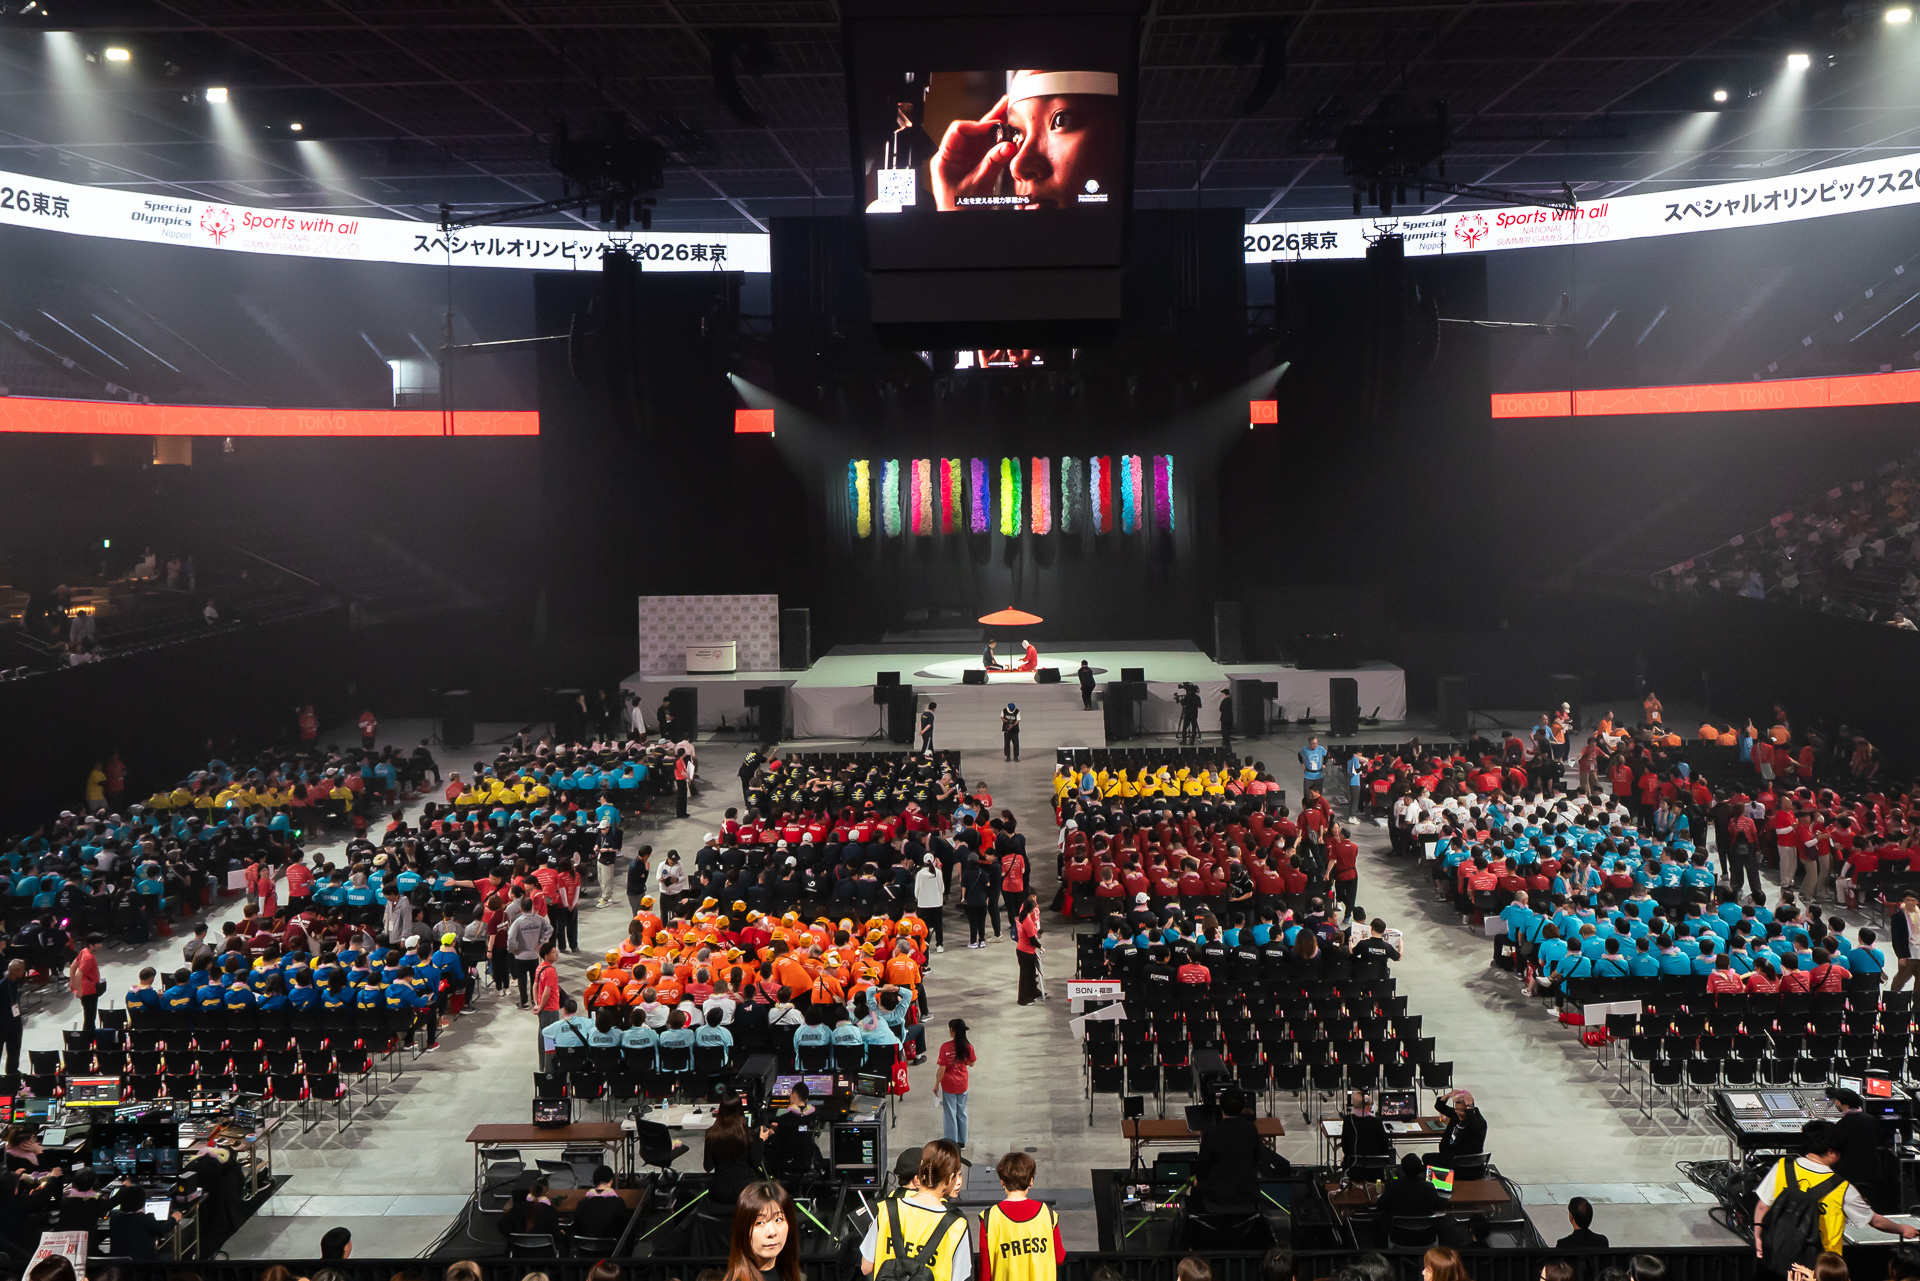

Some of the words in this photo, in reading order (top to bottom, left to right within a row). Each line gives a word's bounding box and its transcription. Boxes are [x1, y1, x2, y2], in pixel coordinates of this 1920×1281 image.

[144, 200, 192, 214] Special
[131, 212, 192, 226] Olympics
[243, 212, 295, 230] Sports
[300, 218, 334, 233] with
[338, 221, 359, 235] all
[1496, 209, 1547, 229] Sports
[1589, 203, 1609, 218] all
[1403, 219, 1447, 230] Special
[1522, 225, 1562, 234] NATIONAL
[1565, 221, 1609, 241] 2026
[161, 229, 192, 239] Nippon
[1400, 231, 1447, 241] lympics
[1497, 236, 1531, 246] SUMMER
[1533, 233, 1562, 243] GAMES
[413, 234, 728, 262] スペシャルオリンピック2026東京
[1419, 242, 1447, 251] Nippon
[1739, 387, 1784, 404] TOKYO
[1499, 397, 1549, 412] TOKYO
[96, 410, 134, 428] TOKYO
[297, 415, 347, 431] TOKYO
[1000, 1237, 1048, 1259] PRESS
